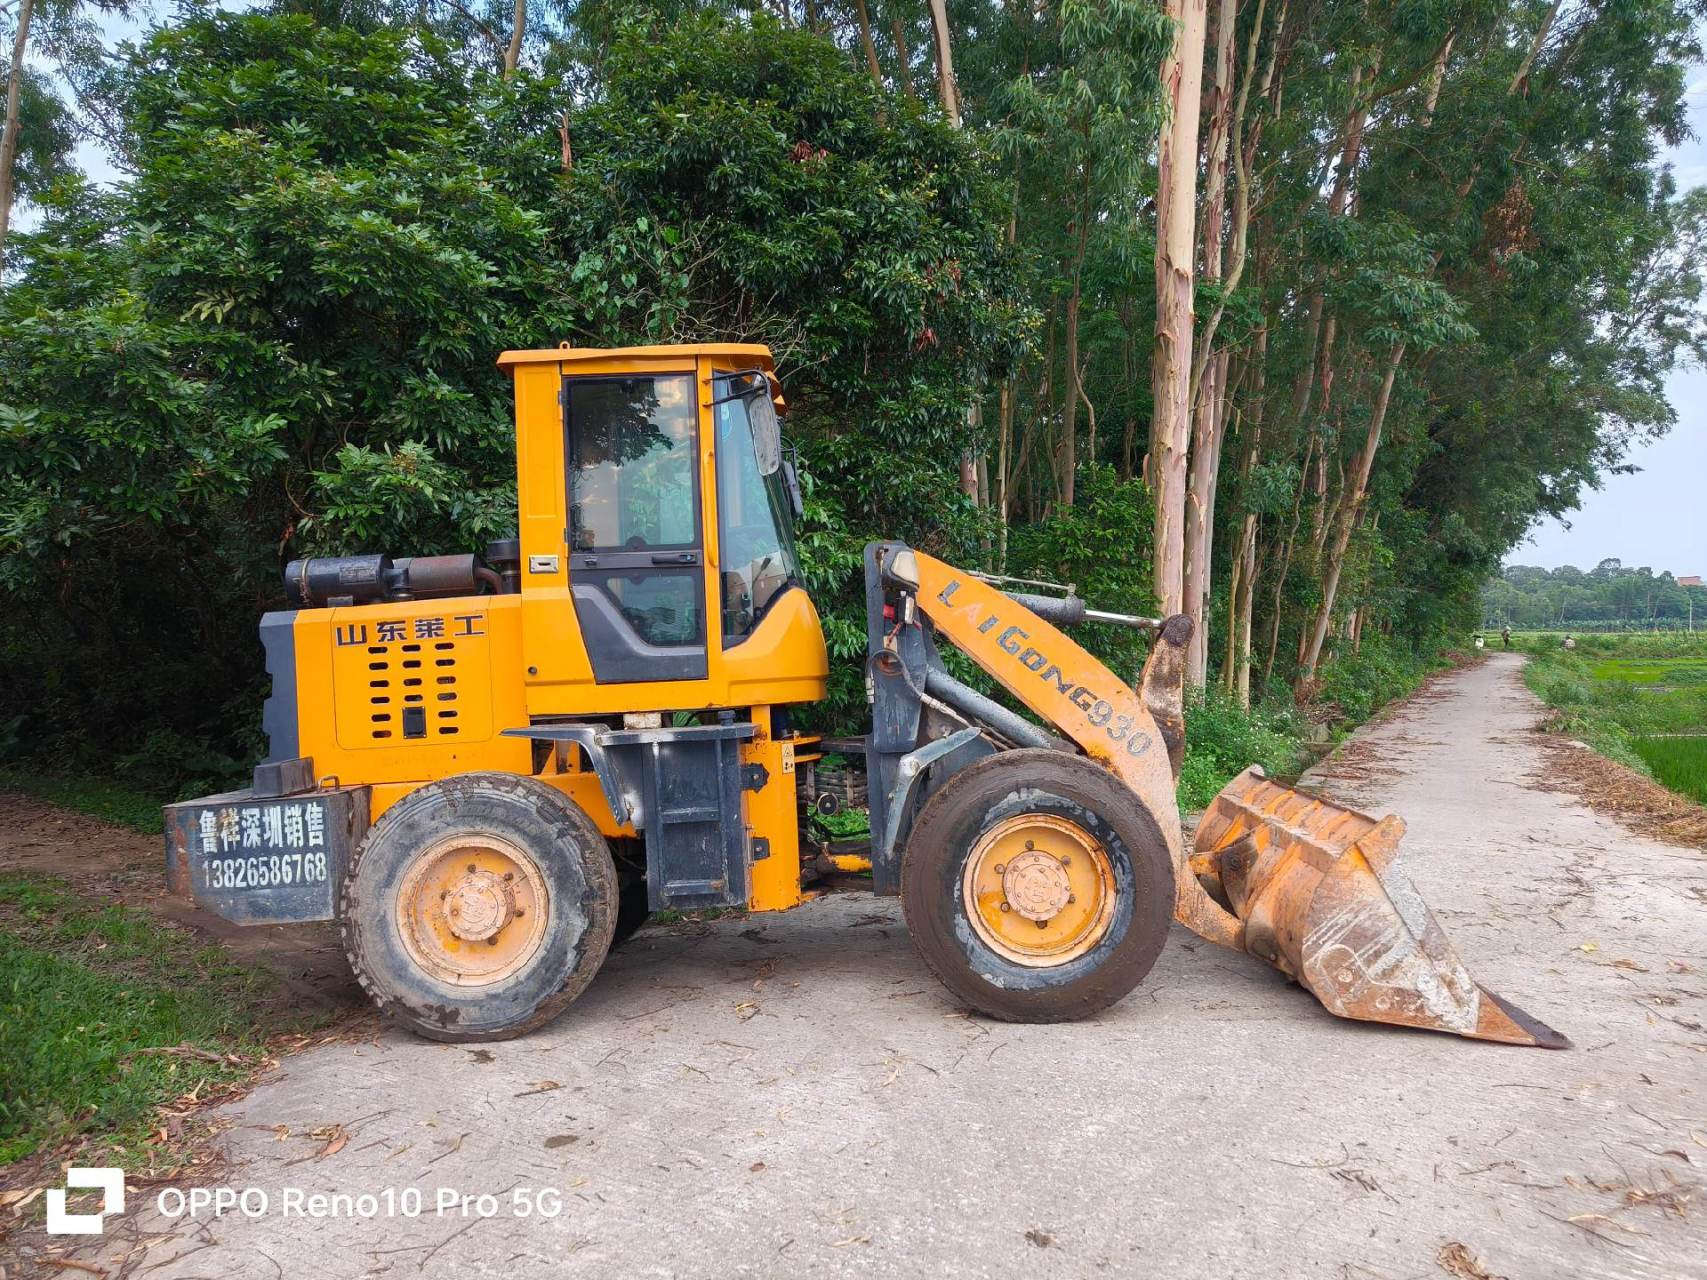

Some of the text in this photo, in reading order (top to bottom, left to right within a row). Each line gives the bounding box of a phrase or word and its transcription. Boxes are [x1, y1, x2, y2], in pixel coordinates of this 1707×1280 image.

[336, 614, 485, 646] 山东莱工
[199, 801, 324, 853] 鲁祥深圳销售
[202, 852, 327, 888] 13826586768
